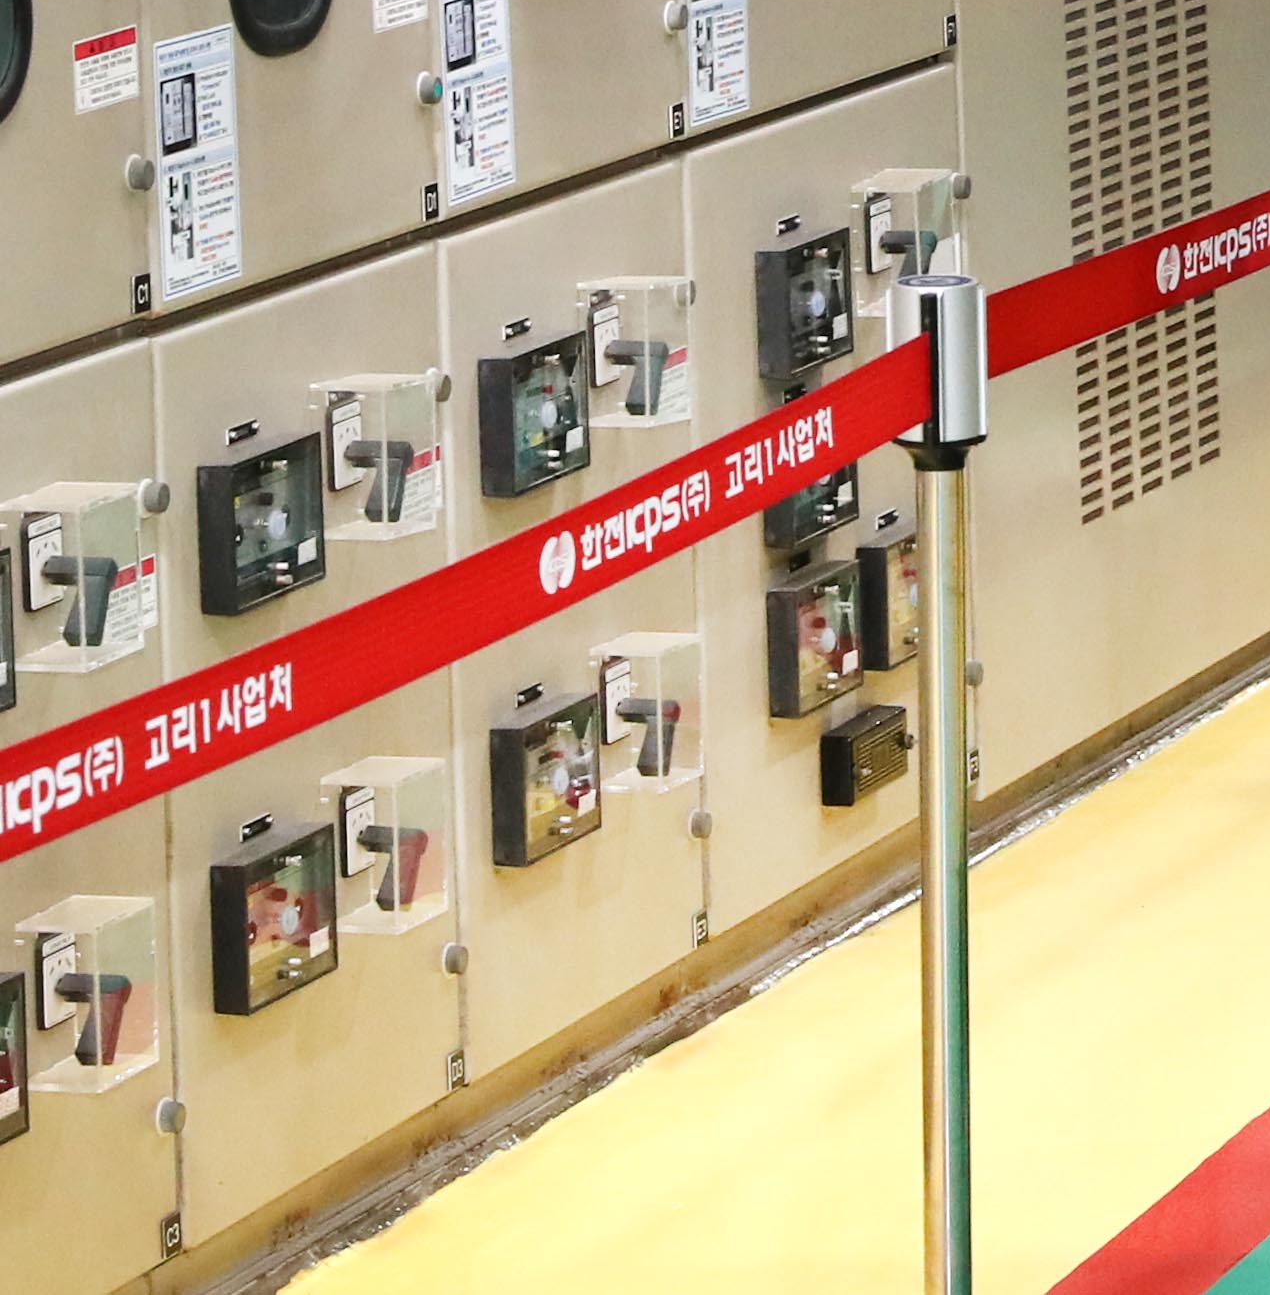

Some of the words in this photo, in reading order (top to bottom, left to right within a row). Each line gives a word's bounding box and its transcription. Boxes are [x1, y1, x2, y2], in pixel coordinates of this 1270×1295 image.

[426, 192, 437, 212] D1
[137, 282, 149, 304] C1
[451, 1058, 464, 1082] D3
[166, 1222, 180, 1248] C3
